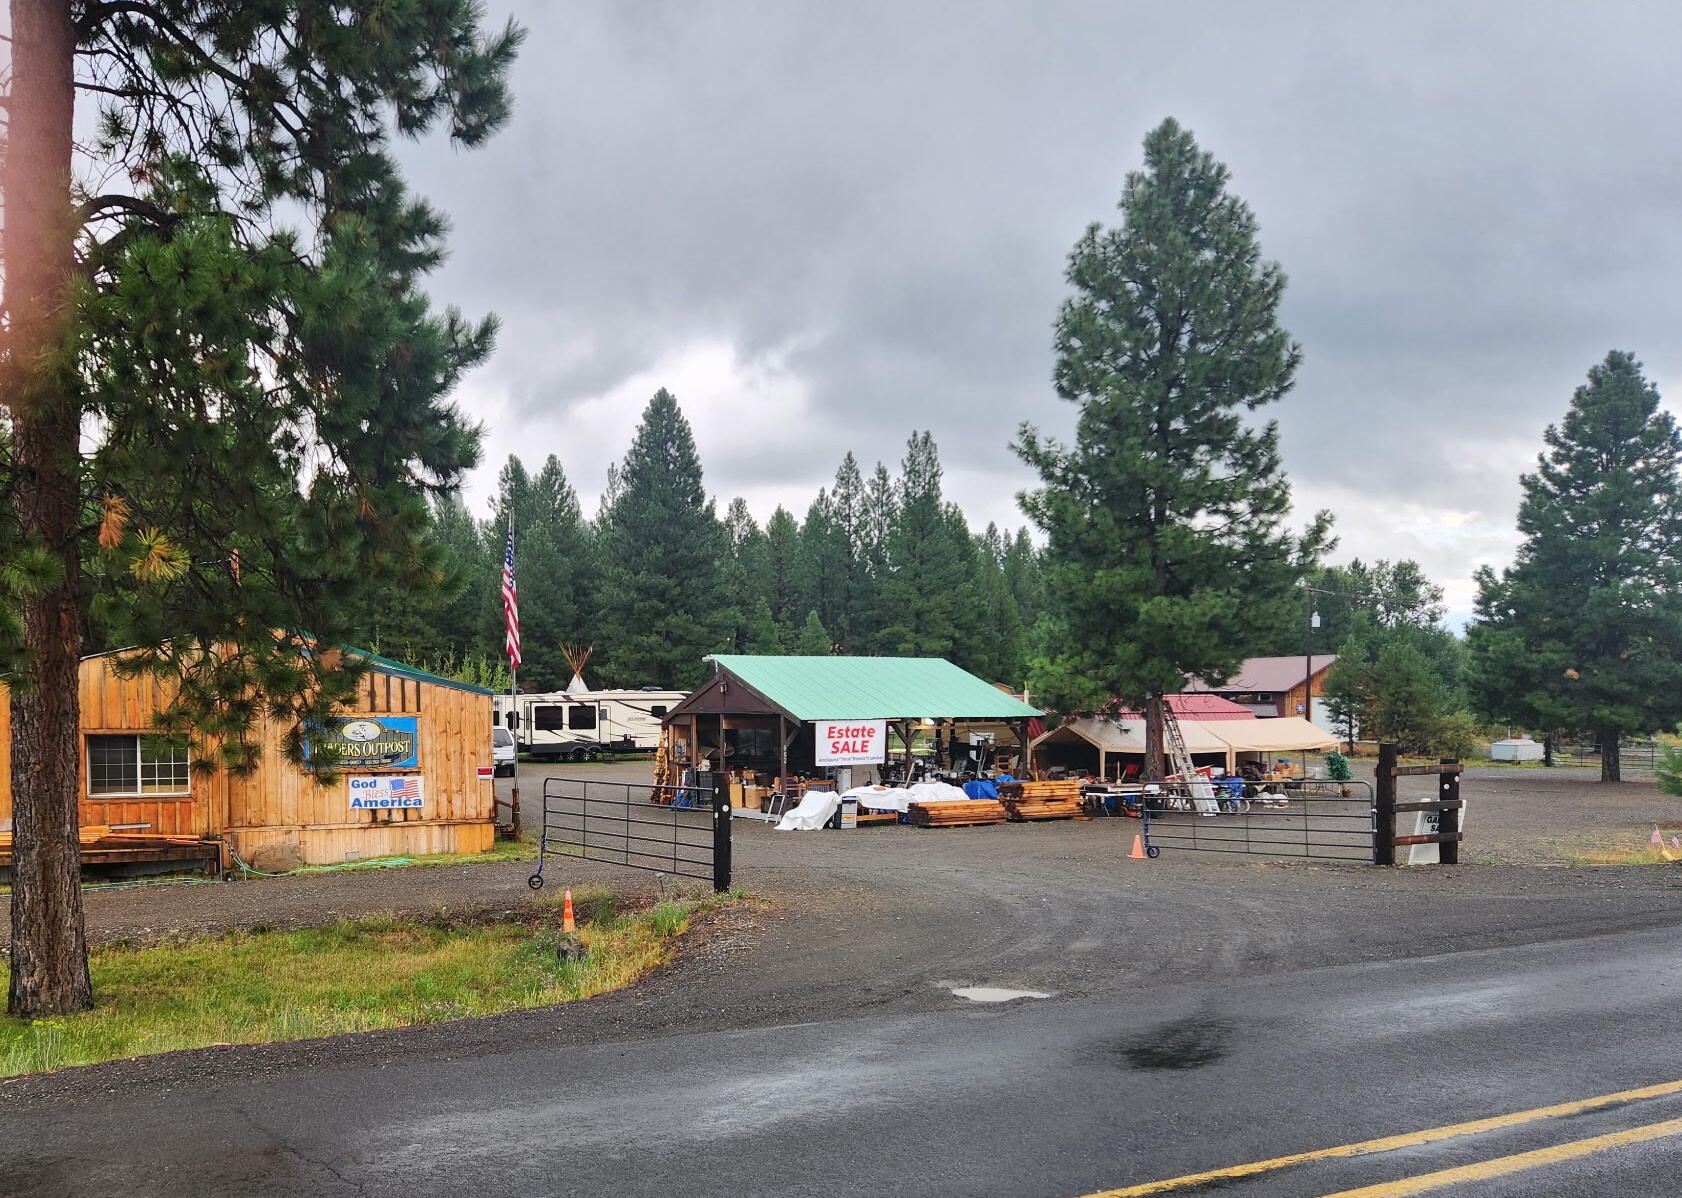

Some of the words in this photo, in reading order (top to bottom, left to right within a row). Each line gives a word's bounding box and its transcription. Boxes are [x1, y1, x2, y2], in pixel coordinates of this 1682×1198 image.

[827, 726, 875, 739] Estate
[830, 740, 869, 755] SALE
[351, 779, 376, 788] God
[361, 789, 388, 800] Bless
[351, 798, 422, 808] America
